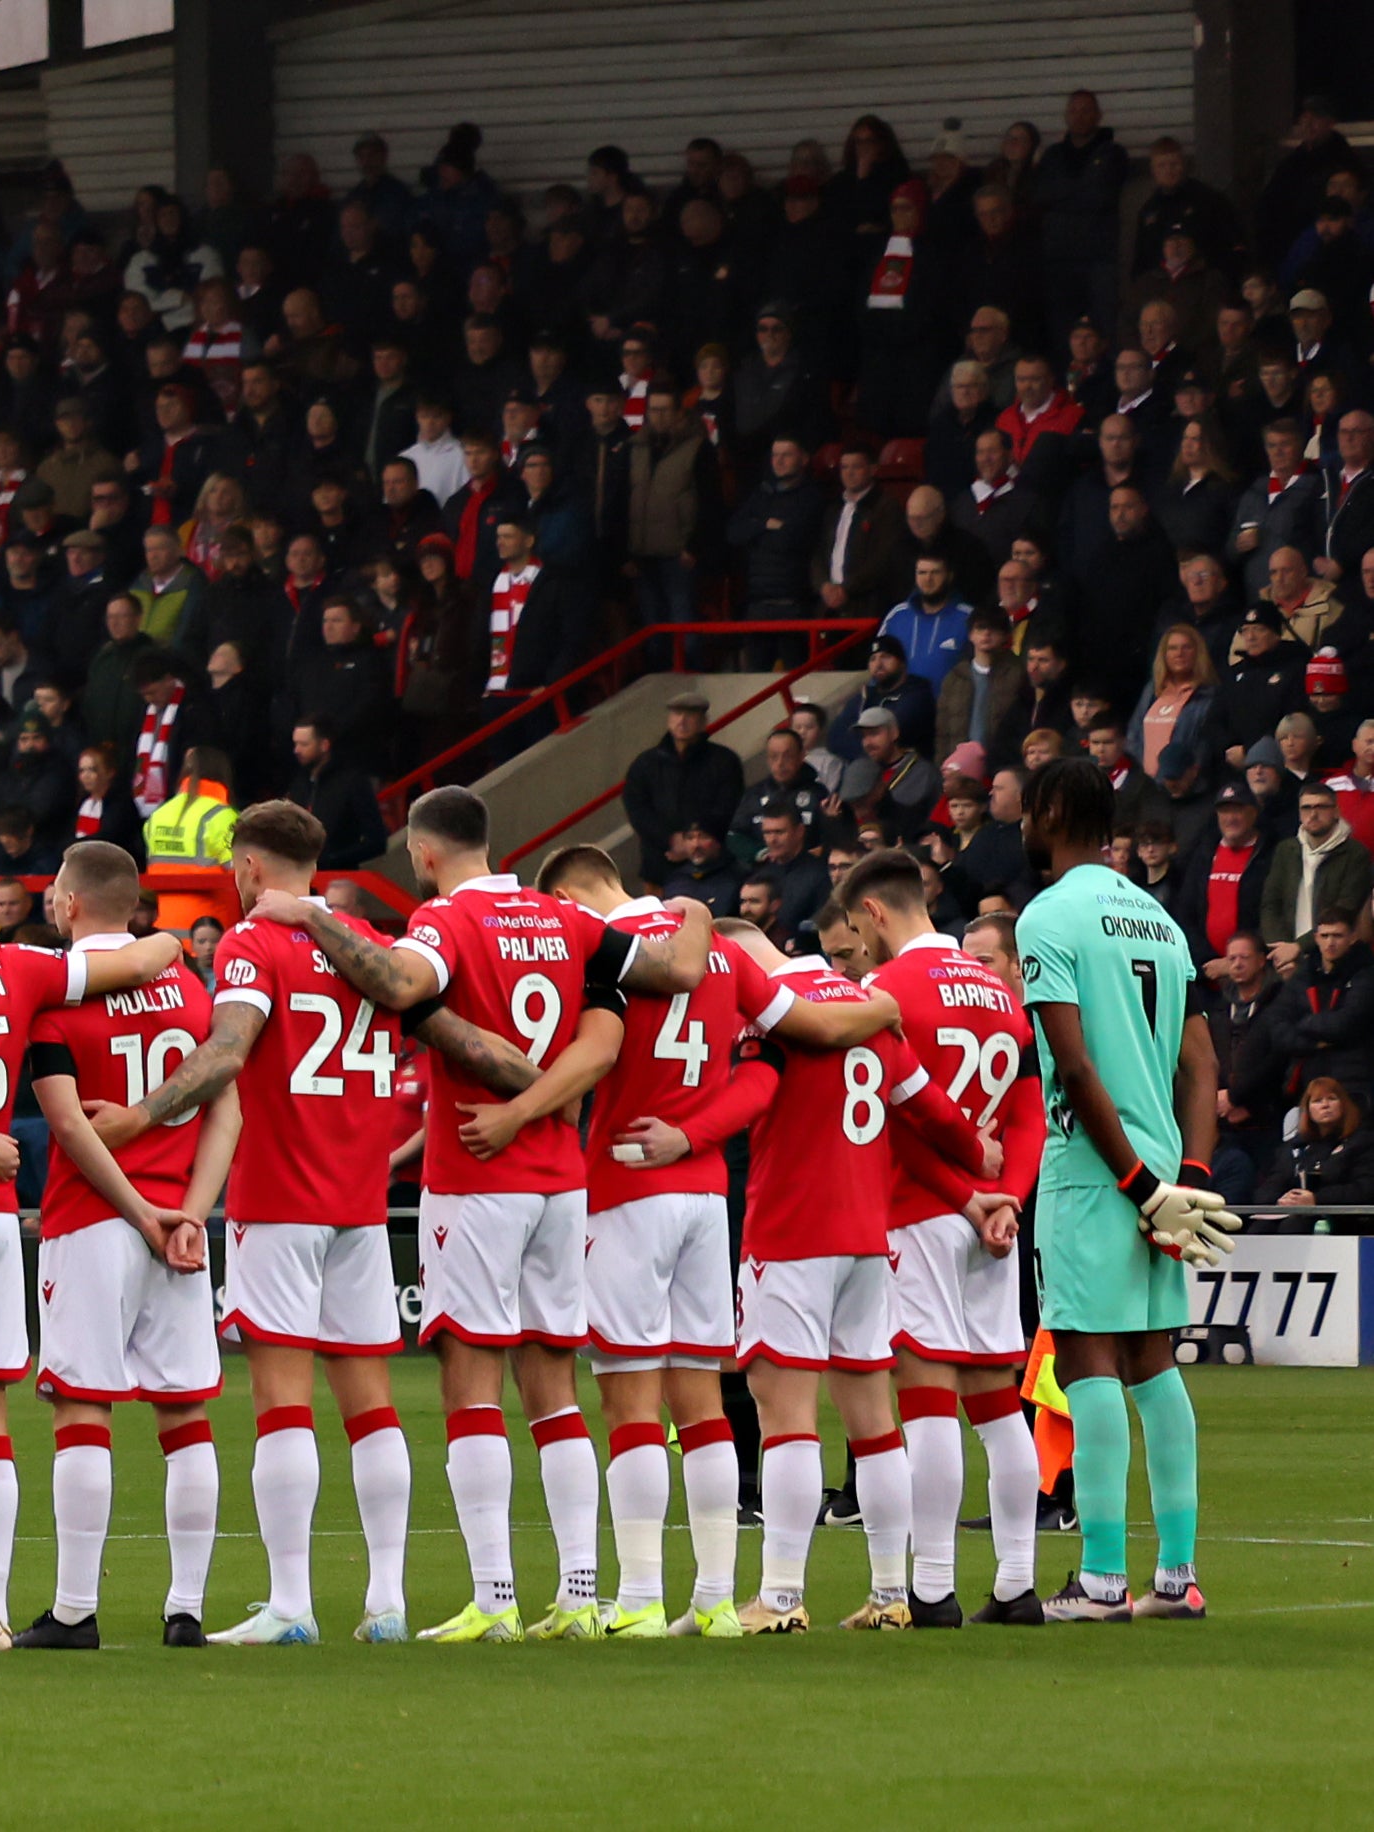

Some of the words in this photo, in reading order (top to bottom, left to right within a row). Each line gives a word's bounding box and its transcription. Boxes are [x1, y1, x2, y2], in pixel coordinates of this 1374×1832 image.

[497, 915, 534, 929] Meta
[497, 936, 570, 962] PALMER
[1101, 915, 1176, 946] OKONKWO
[105, 984, 185, 1017] MULLIN
[510, 972, 562, 1068] 9
[938, 983, 1013, 1015] BARNETT
[1131, 958, 1158, 1043] 1
[290, 992, 396, 1098] 24
[654, 992, 709, 1087] 4
[110, 1028, 200, 1127] 10
[842, 1046, 886, 1146] 8
[1272, 1271, 1339, 1337] 77
